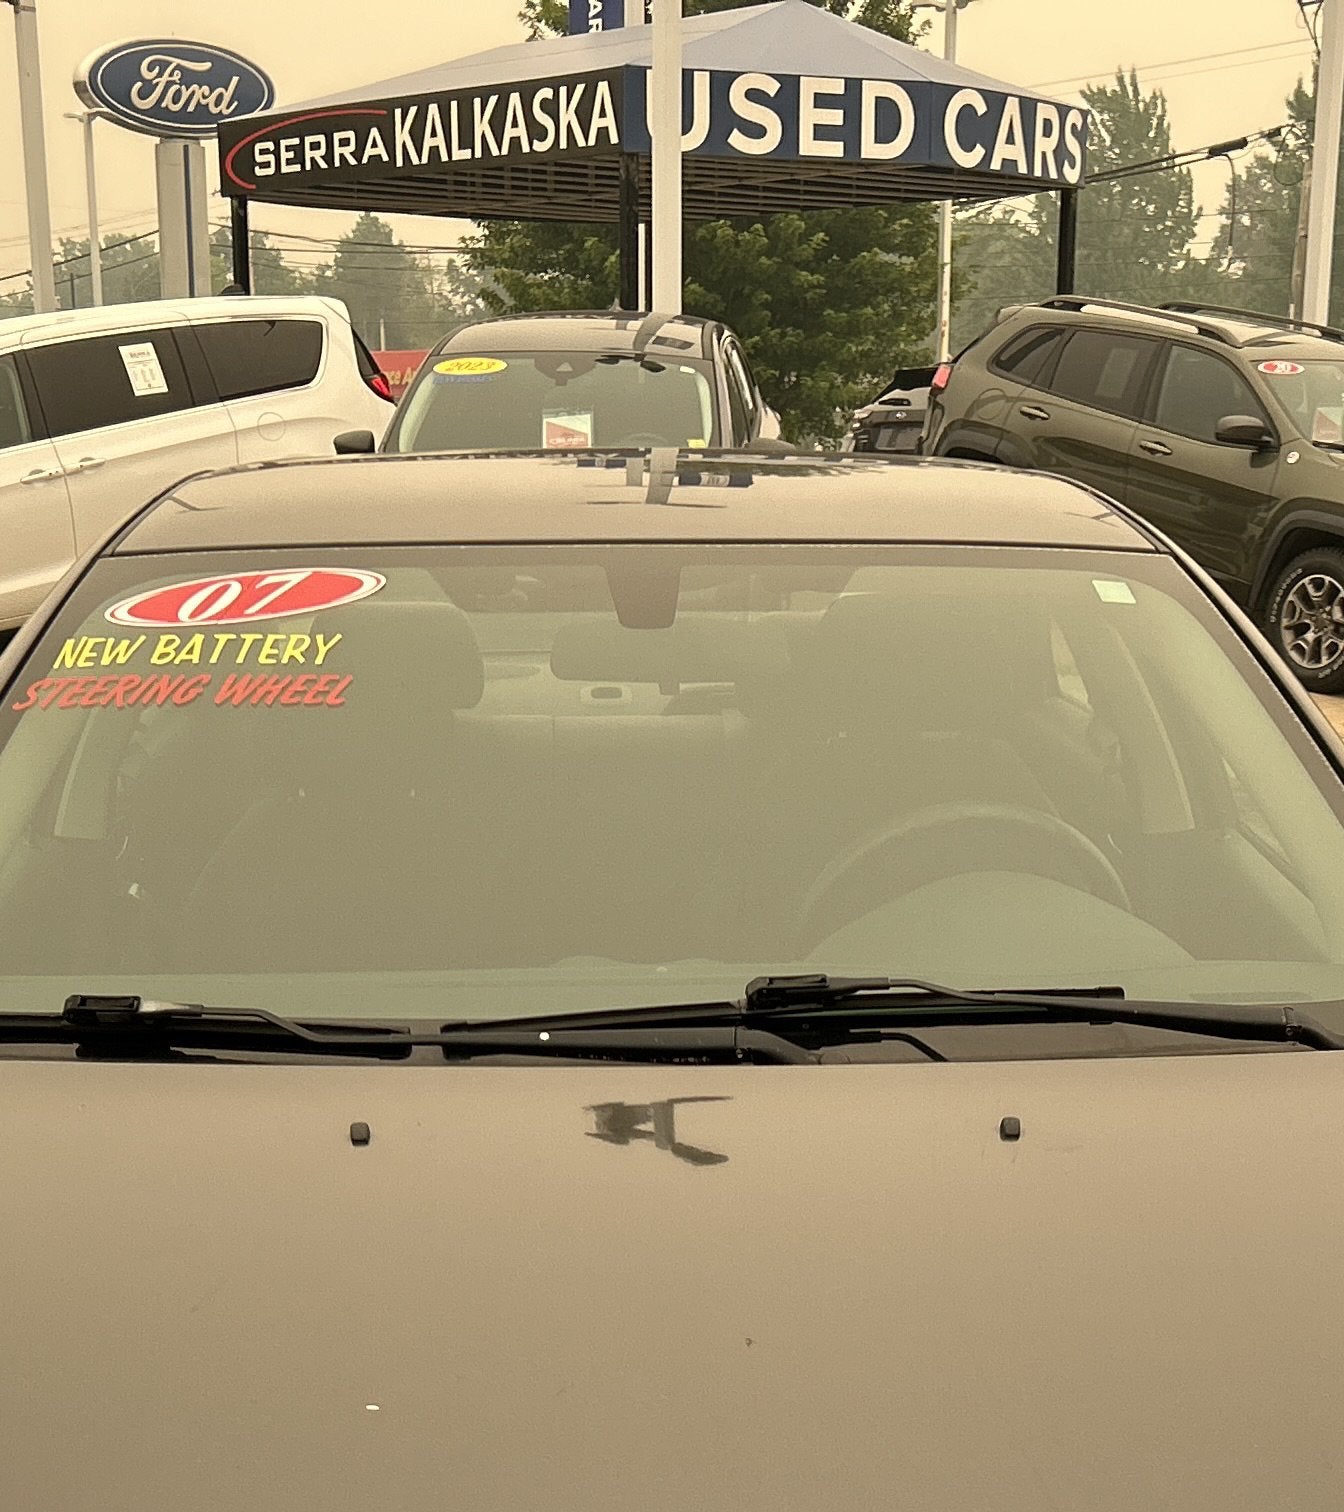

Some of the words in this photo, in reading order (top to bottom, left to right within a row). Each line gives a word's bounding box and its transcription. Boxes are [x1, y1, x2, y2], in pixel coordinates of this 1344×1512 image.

[130, 54, 240, 116] Ford
[254, 126, 390, 177] SERRA
[394, 81, 619, 168] KALKASKA
[646, 69, 916, 160] USED
[943, 88, 1084, 184] CARS
[445, 361, 497, 372] 2023
[178, 570, 315, 623] 07
[53, 634, 147, 669] NEW
[149, 633, 343, 666] BATTERY
[11, 674, 212, 711] STEERING
[213, 674, 354, 710] WHEEL
